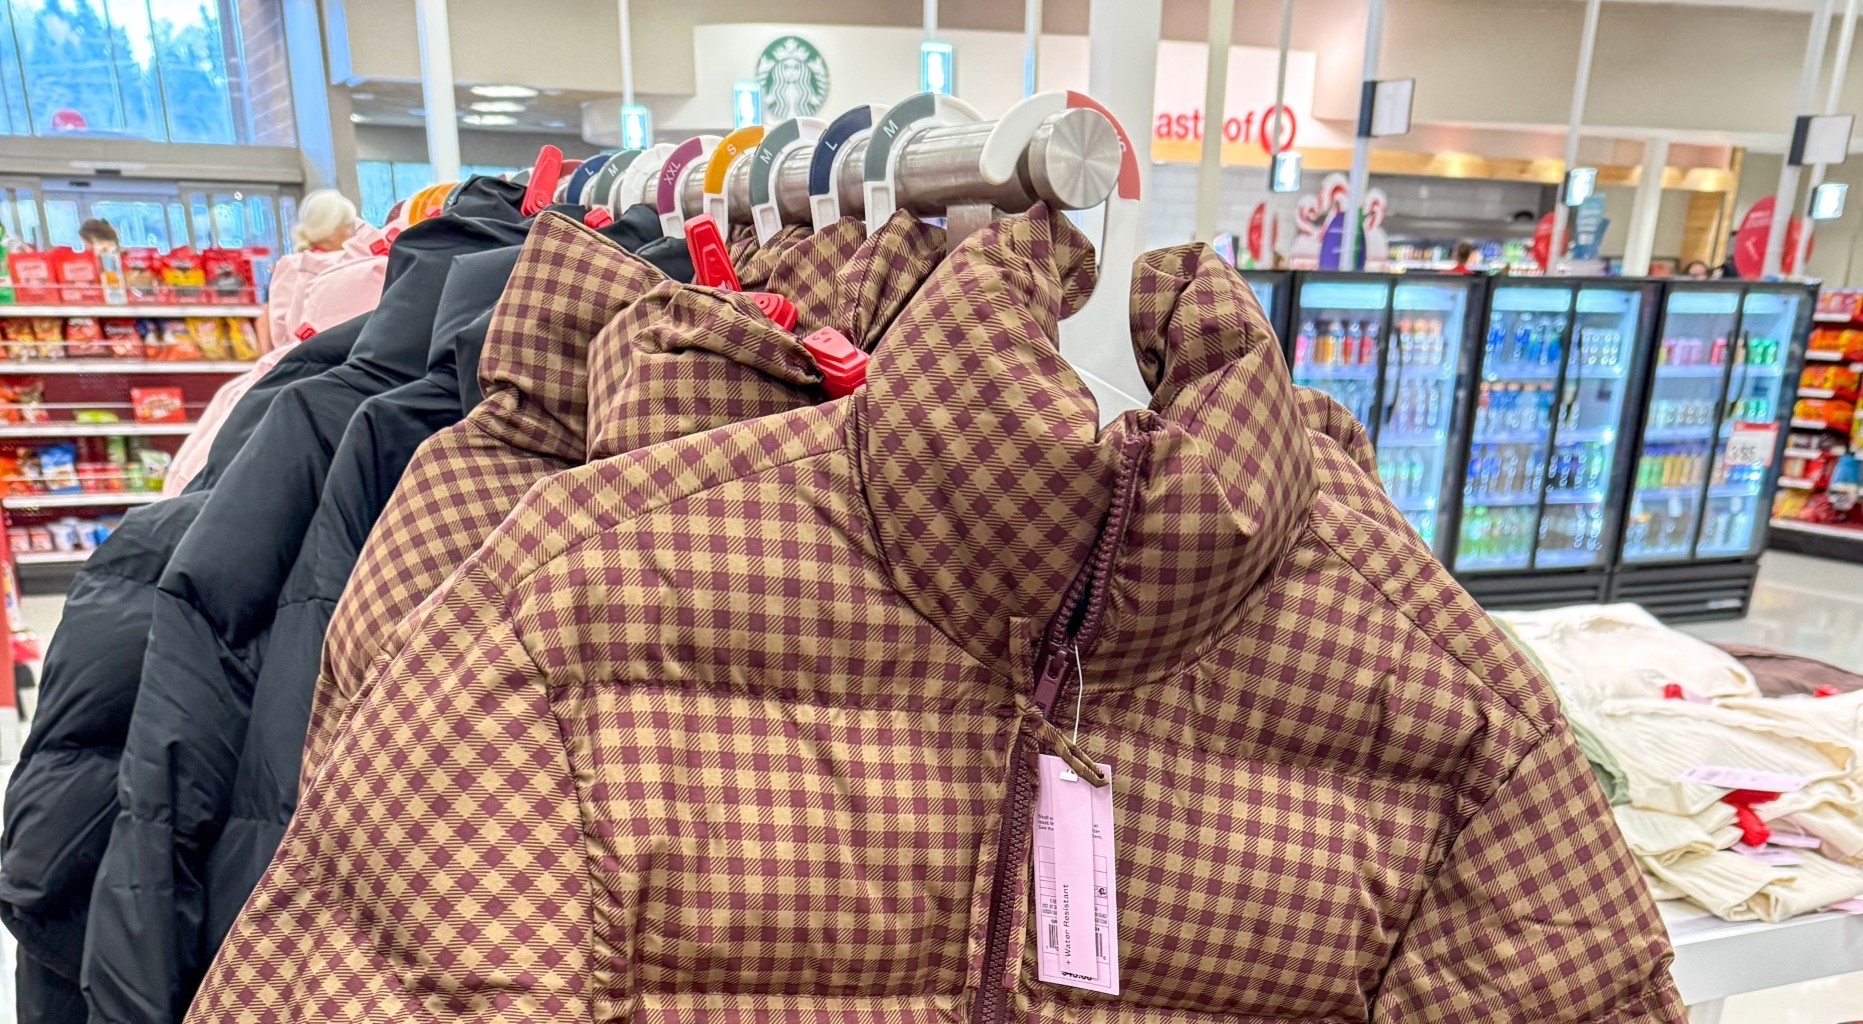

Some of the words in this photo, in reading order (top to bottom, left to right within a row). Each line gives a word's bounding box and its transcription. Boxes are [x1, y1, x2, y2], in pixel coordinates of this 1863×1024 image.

[882, 119, 898, 139] M
[1156, 109, 1203, 140] ast
[1223, 110, 1254, 143] of
[726, 143, 737, 156] S
[825, 140, 838, 152] L
[759, 149, 773, 165] M
[585, 167, 594, 176] L
[607, 163, 618, 177] M
[663, 161, 681, 186] XXL
